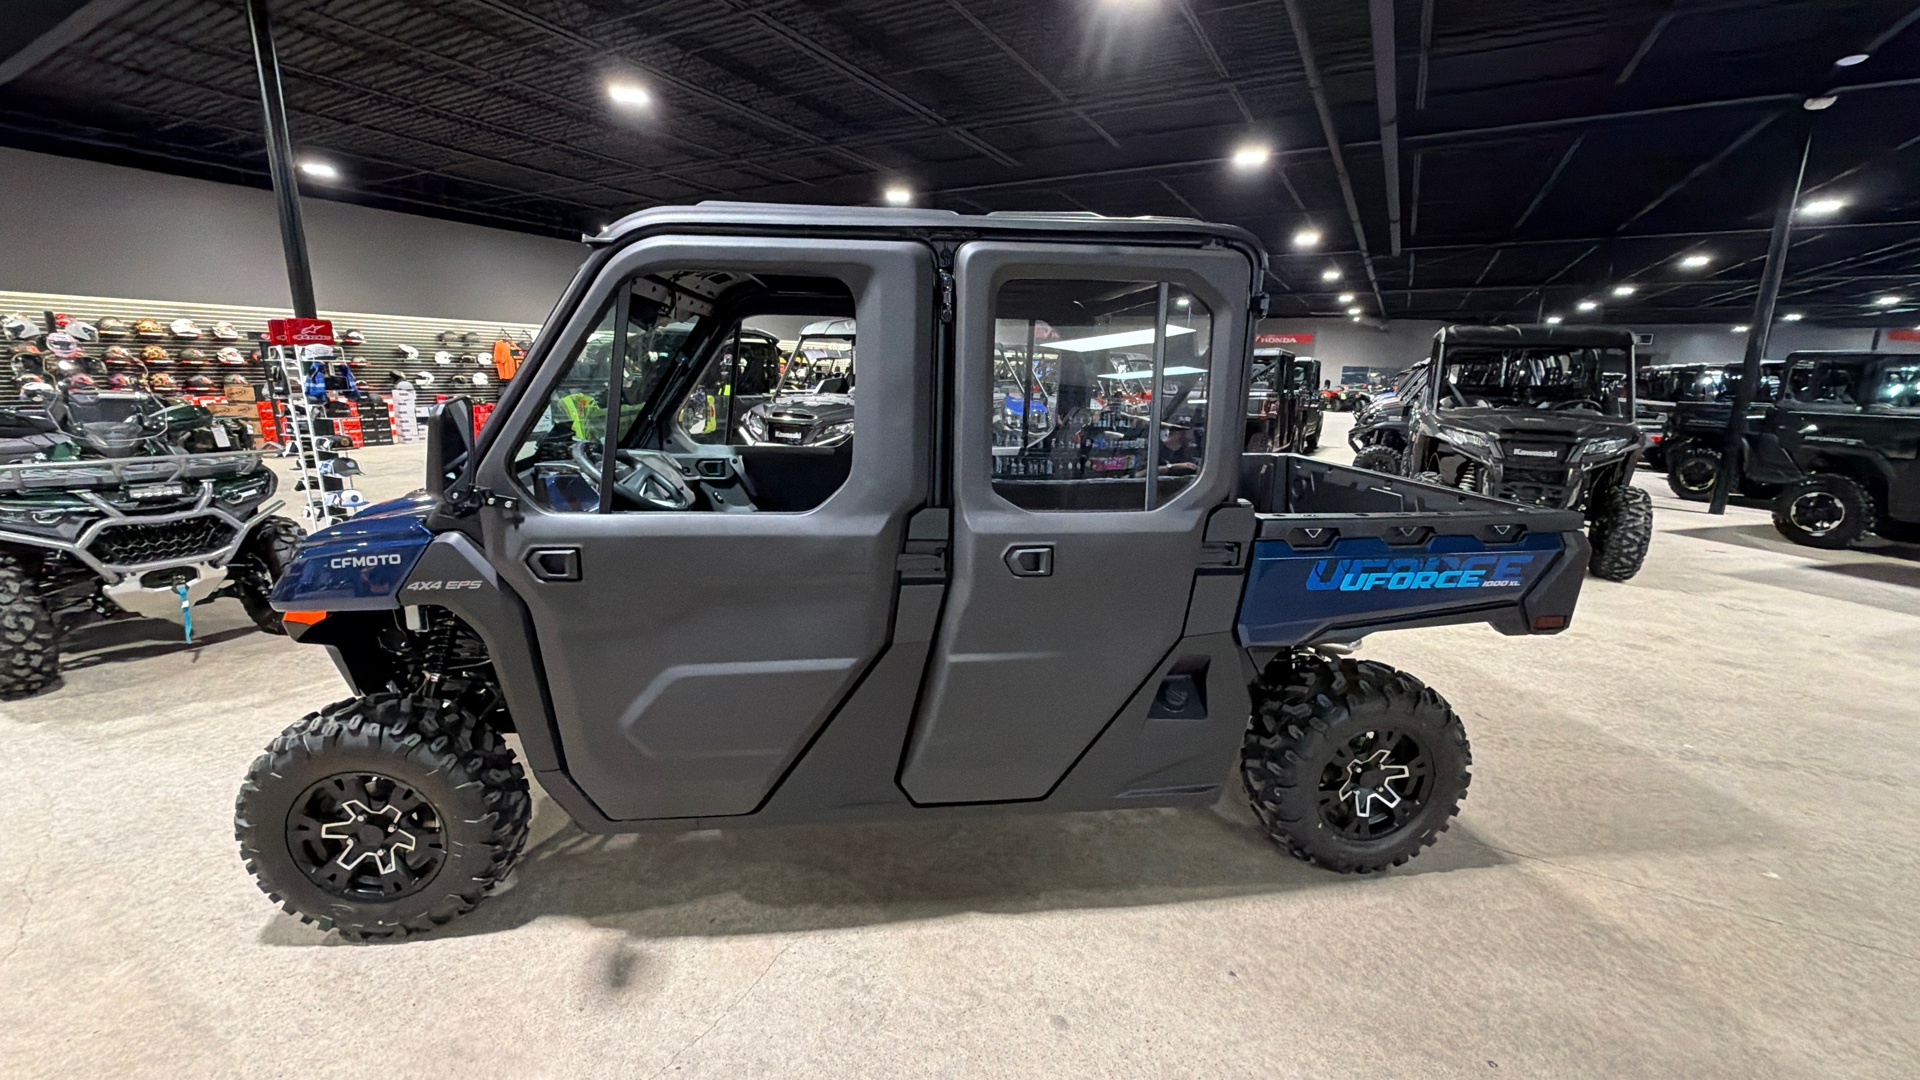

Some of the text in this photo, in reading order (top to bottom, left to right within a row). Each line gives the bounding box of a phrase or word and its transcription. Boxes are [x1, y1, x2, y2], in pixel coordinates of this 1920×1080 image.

[1513, 448, 1558, 458] Kawasaki
[330, 553, 402, 569] CFMOTO
[407, 580, 483, 591] 4X4 EPS
[1339, 569, 1487, 592] UFORCE
[1482, 580, 1508, 588] 1000
